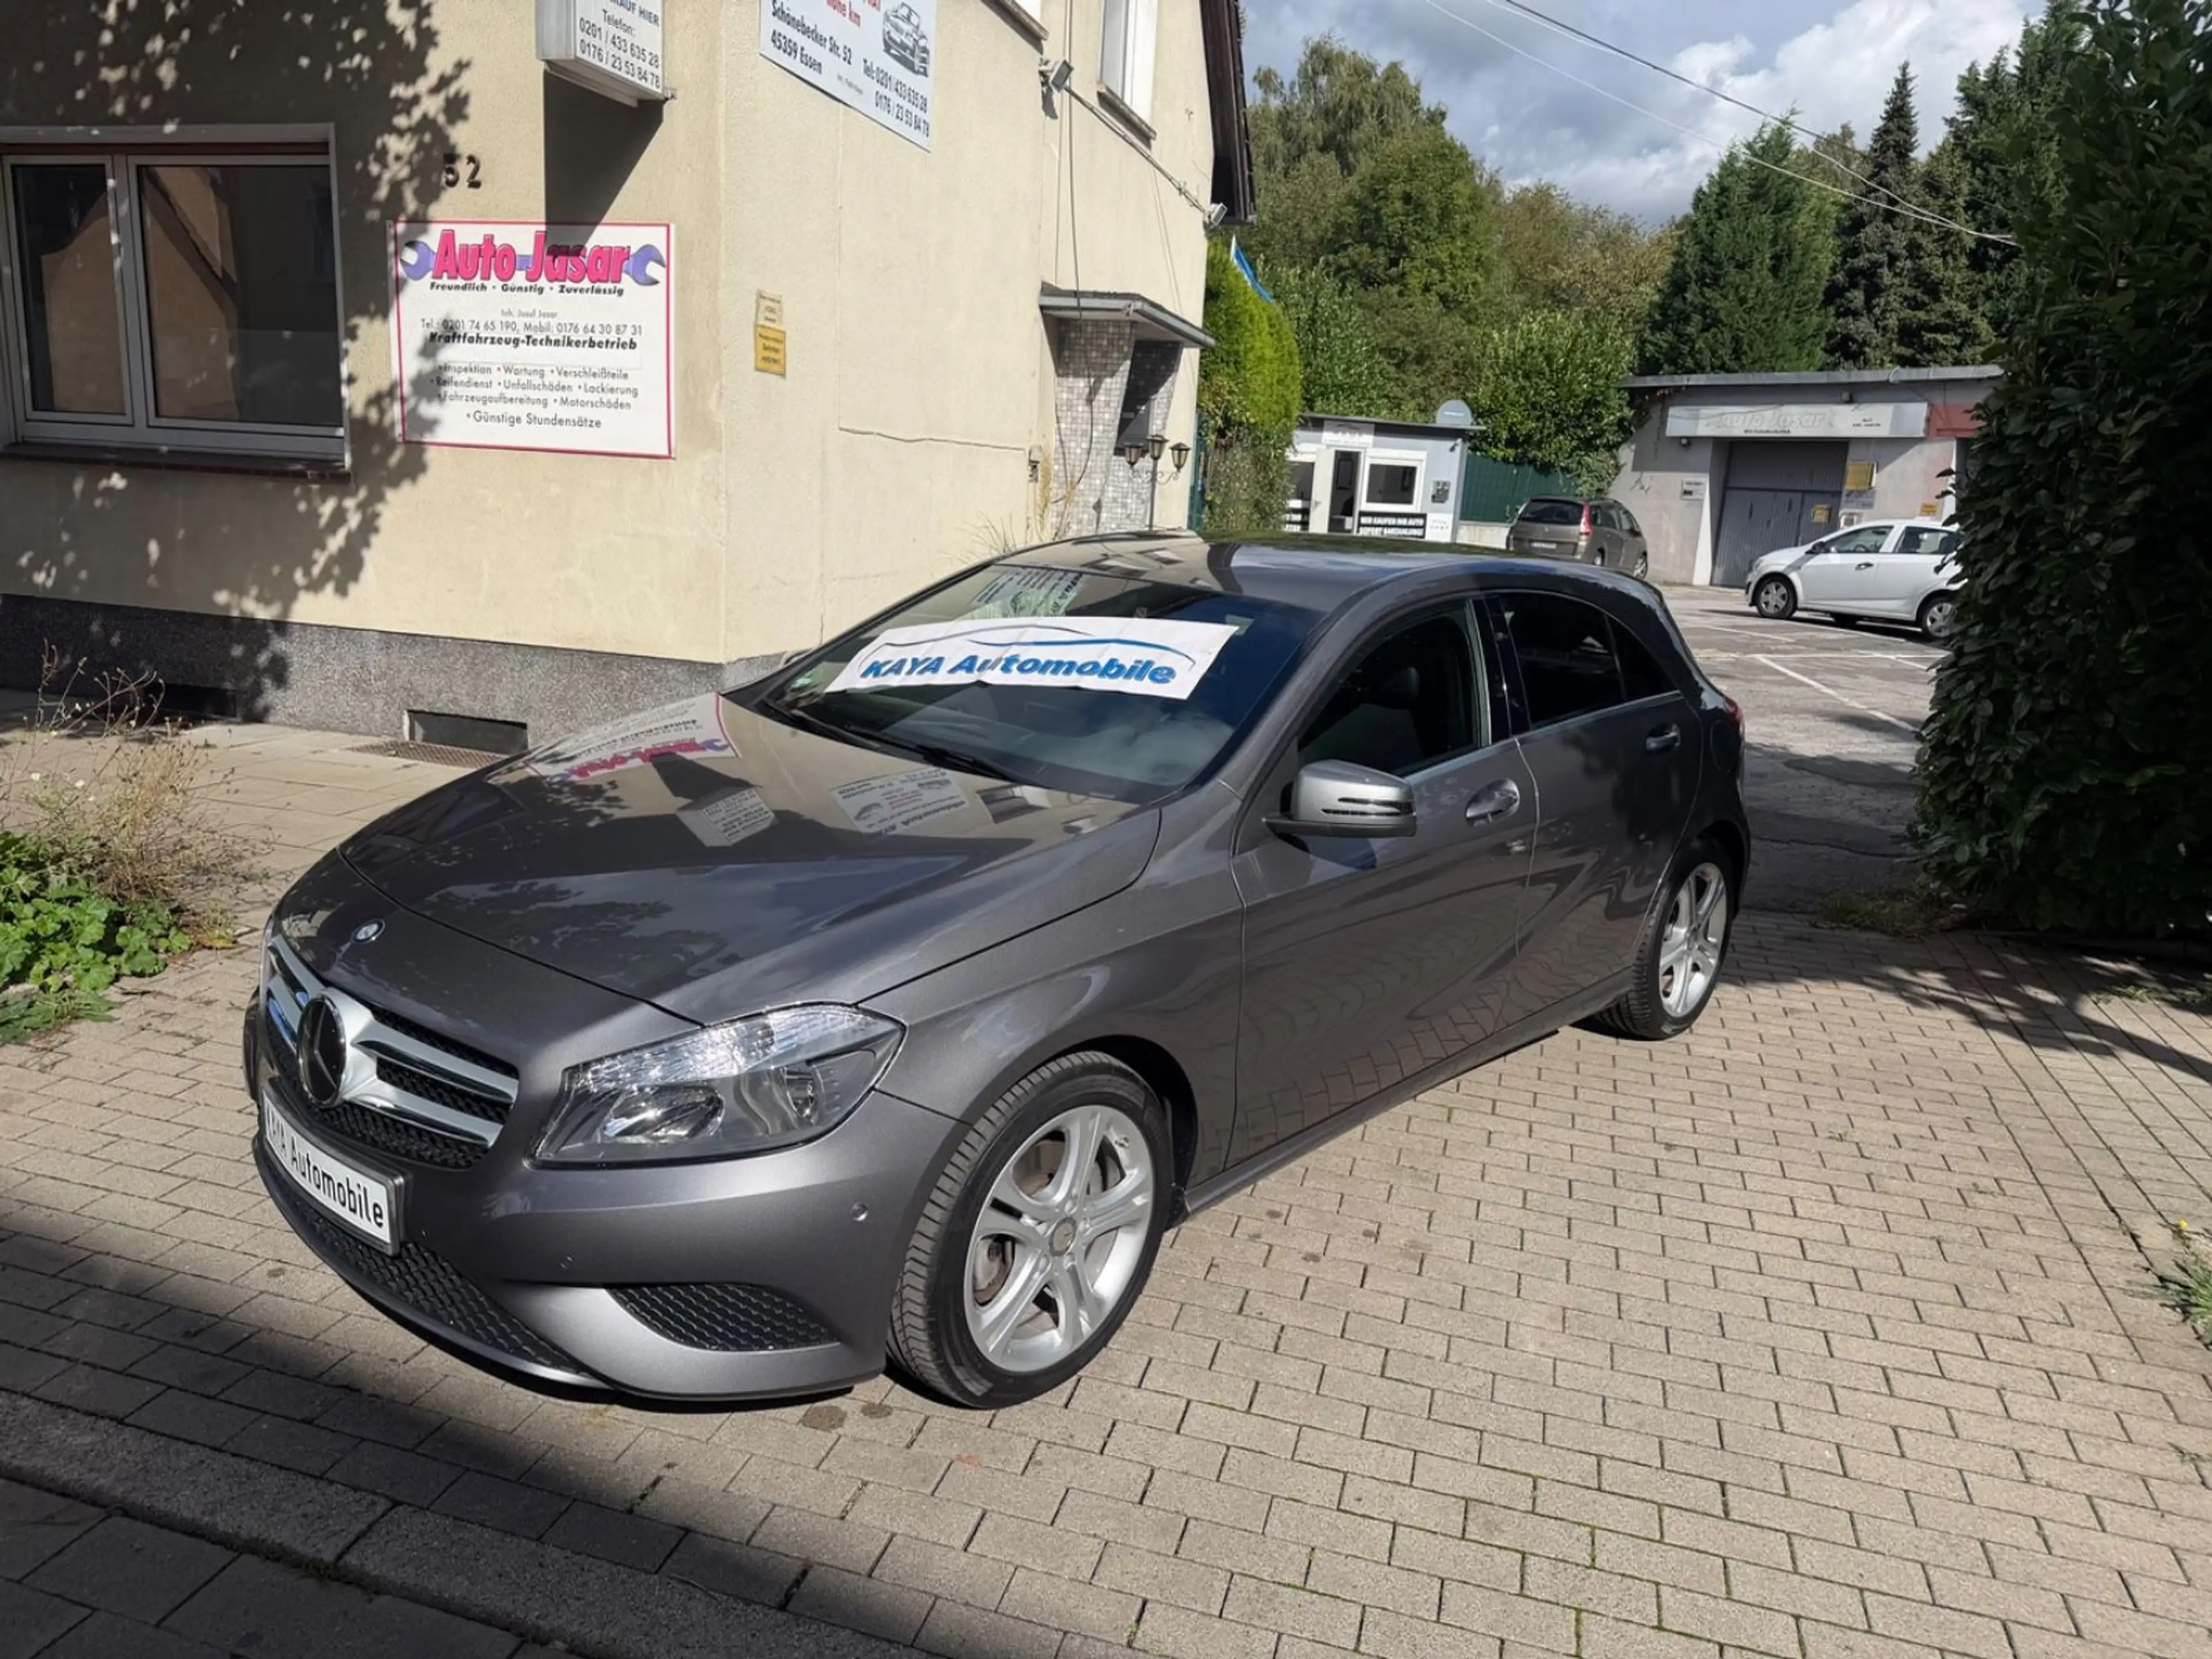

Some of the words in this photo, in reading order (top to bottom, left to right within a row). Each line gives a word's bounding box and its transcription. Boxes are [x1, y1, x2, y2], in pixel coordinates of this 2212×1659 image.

[638, 6, 660, 27] HIER
[579, 17, 603, 41] 0201
[611, 33, 628, 53] 433
[631, 43, 646, 62] 635
[649, 52, 660, 69] 28
[771, 29, 798, 60] 45359
[800, 46, 822, 75] Essen
[829, 36, 841, 58] Str.
[843, 44, 852, 65] 52
[579, 39, 604, 63] 0176
[611, 54, 622, 71] 23
[624, 60, 635, 77] 53
[638, 66, 648, 84] 84
[650, 72, 660, 89] 78
[431, 229, 517, 282] Auto
[525, 230, 631, 284] Jasar
[430, 282, 488, 291] Freundlich
[501, 282, 544, 295] Günstig
[559, 284, 624, 297] Zuverlässig
[442, 319, 464, 330] 0201
[469, 320, 480, 331] 74
[484, 320, 495, 331] 65
[556, 322, 579, 334] 0176
[582, 323, 595, 334] 64
[599, 323, 612, 335] 30
[631, 324, 642, 336] 31
[429, 332, 637, 350] Kraftfahrzeug-Technikerbetrieb
[442, 363, 492, 374] Inspektion
[503, 365, 545, 379] Wartung
[503, 378, 573, 392] Unfallschäden
[584, 382, 638, 398] Lackierung
[559, 396, 631, 410] Motorschäden
[473, 410, 522, 426] Günstige
[527, 412, 602, 428] Stundensätze
[860, 656, 945, 679] KAYA
[947, 654, 1176, 684] Automobile
[291, 1135, 384, 1229] Automobile
